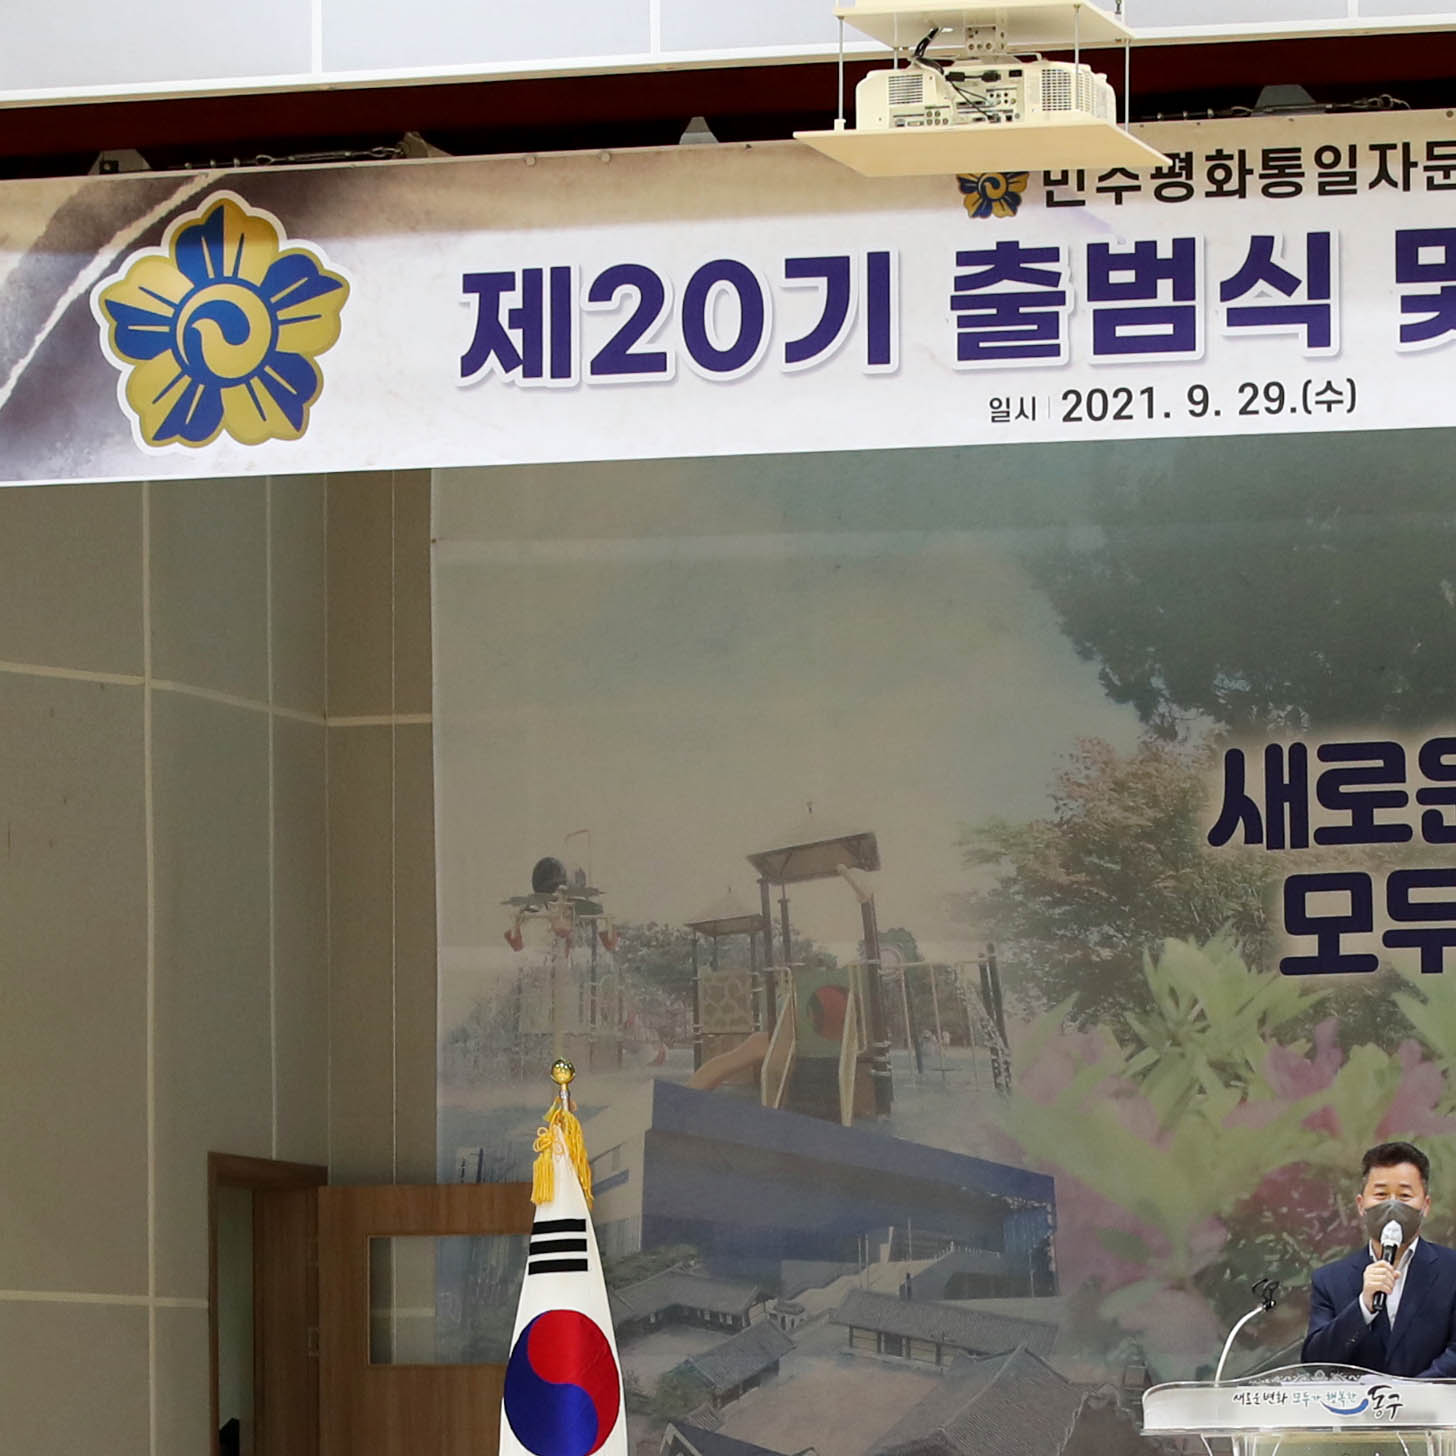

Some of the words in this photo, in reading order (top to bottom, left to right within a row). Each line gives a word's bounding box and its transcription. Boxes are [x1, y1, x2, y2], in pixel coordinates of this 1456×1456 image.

[459, 250, 892, 379] 제20기
[948, 230, 1332, 362] 출범식
[988, 395, 1037, 424] 일시
[1061, 386, 1172, 424] 2021.
[1187, 384, 1222, 418] 9.
[1237, 377, 1357, 417] 29.(수)
[1367, 1384, 1404, 1420] 동구
